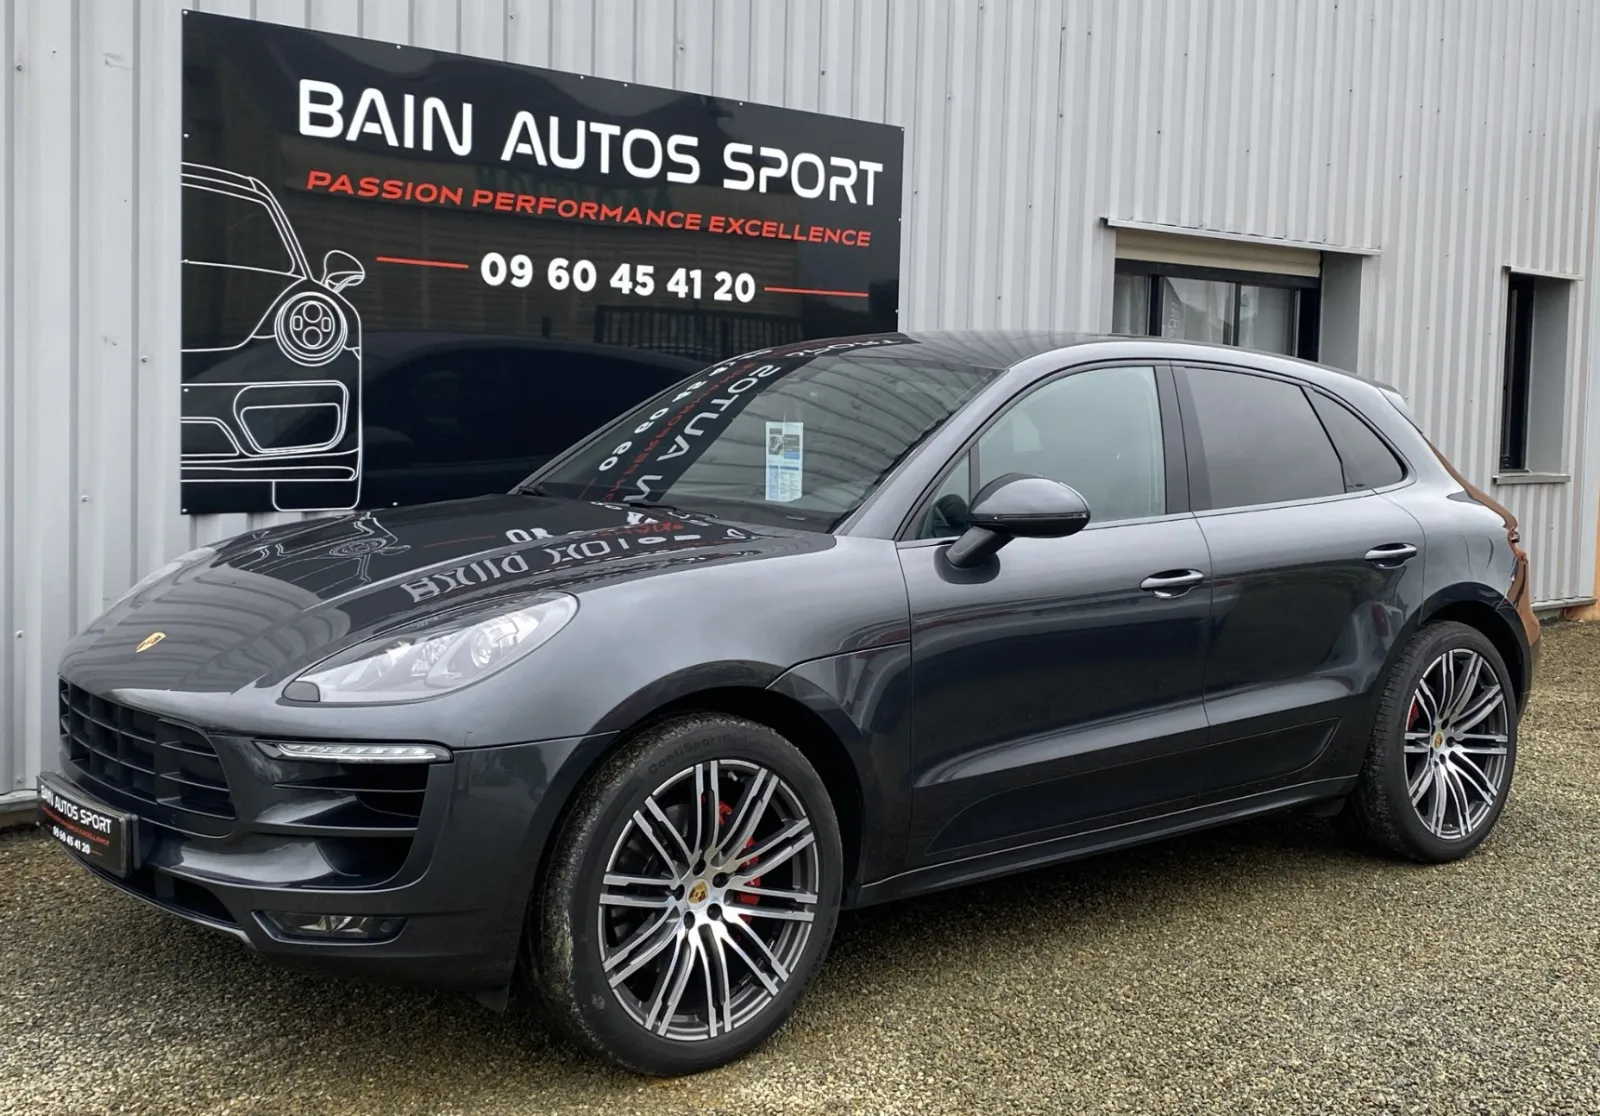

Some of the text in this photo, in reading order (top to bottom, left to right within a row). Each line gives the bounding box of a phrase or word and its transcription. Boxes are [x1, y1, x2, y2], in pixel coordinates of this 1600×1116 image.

[299, 78, 473, 156] BAIN
[500, 110, 701, 184] AUTOS
[722, 142, 884, 206] SPORT
[306, 170, 464, 205] PASSION
[471, 189, 702, 232] PERFORMANCE
[708, 215, 872, 248] EXCELLENCE
[480, 252, 756, 304] 09 60 45 41 20
[55, 796, 78, 821] AUTOS
[80, 809, 111, 834] SPORT
